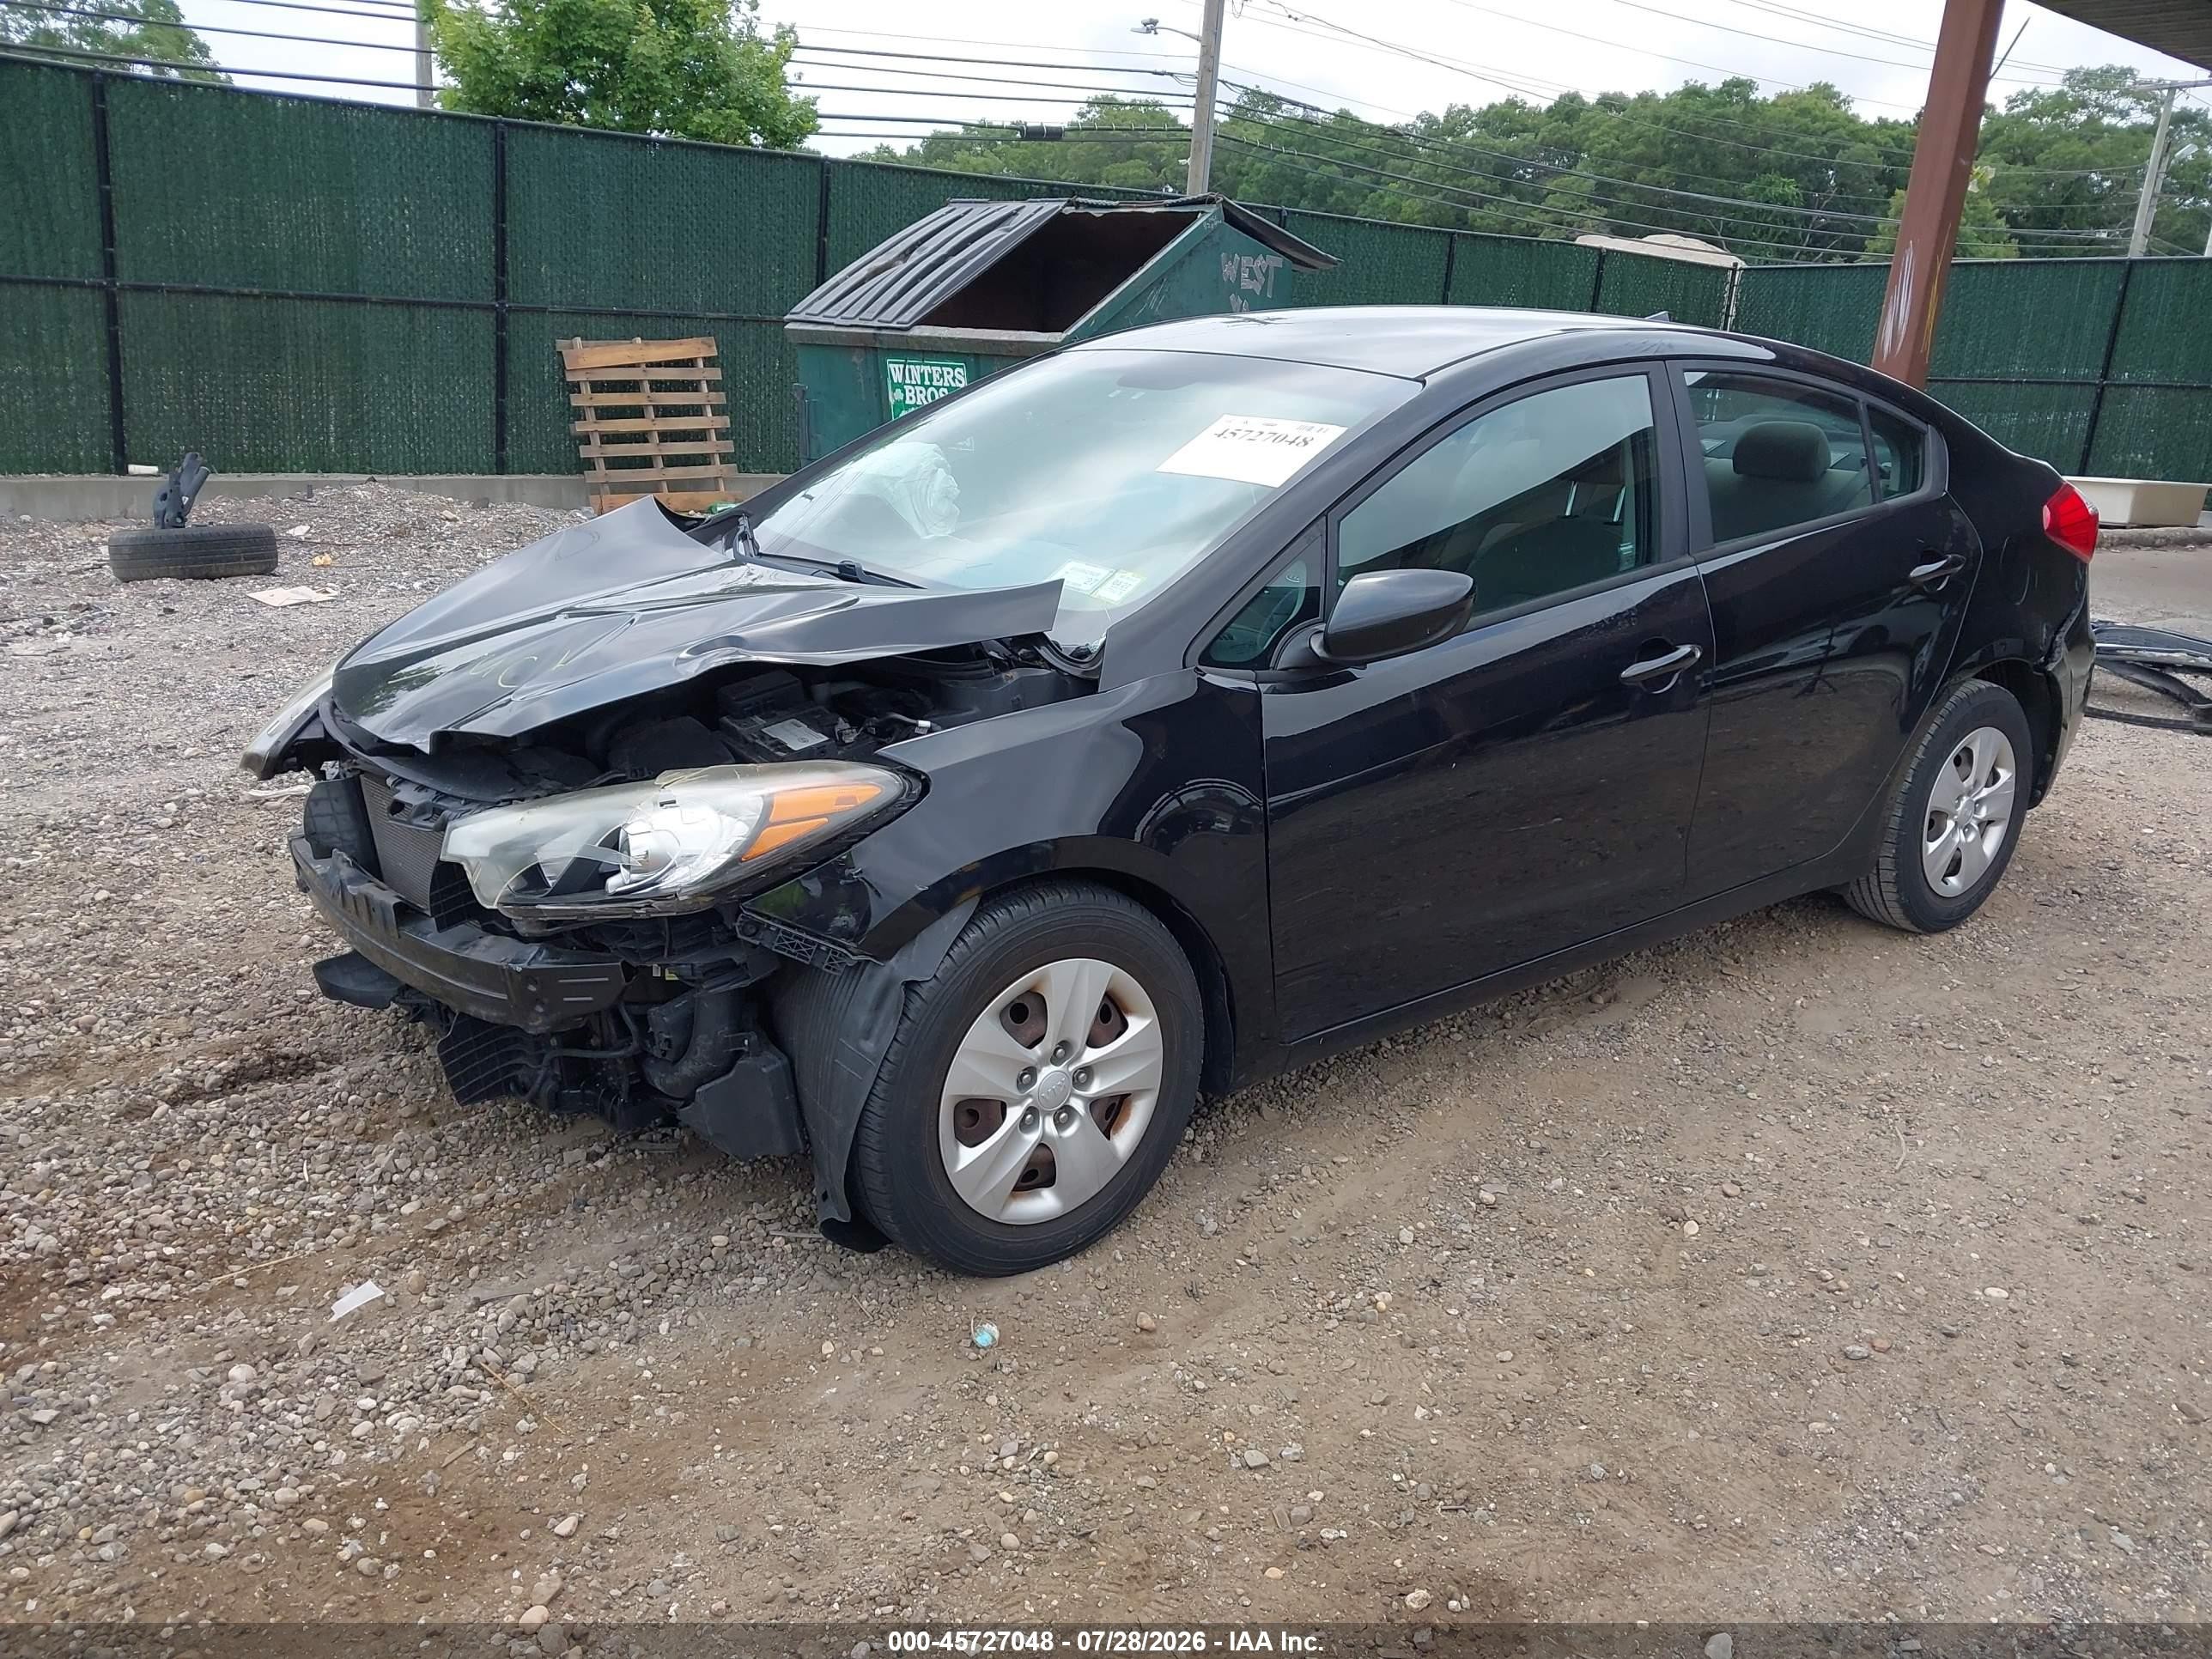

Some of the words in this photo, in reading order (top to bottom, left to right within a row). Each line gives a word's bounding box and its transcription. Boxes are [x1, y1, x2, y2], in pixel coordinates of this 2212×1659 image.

[1221, 252, 1283, 298] WEST
[889, 363, 966, 387] WINTERS
[1213, 428, 1314, 447] 45727048
